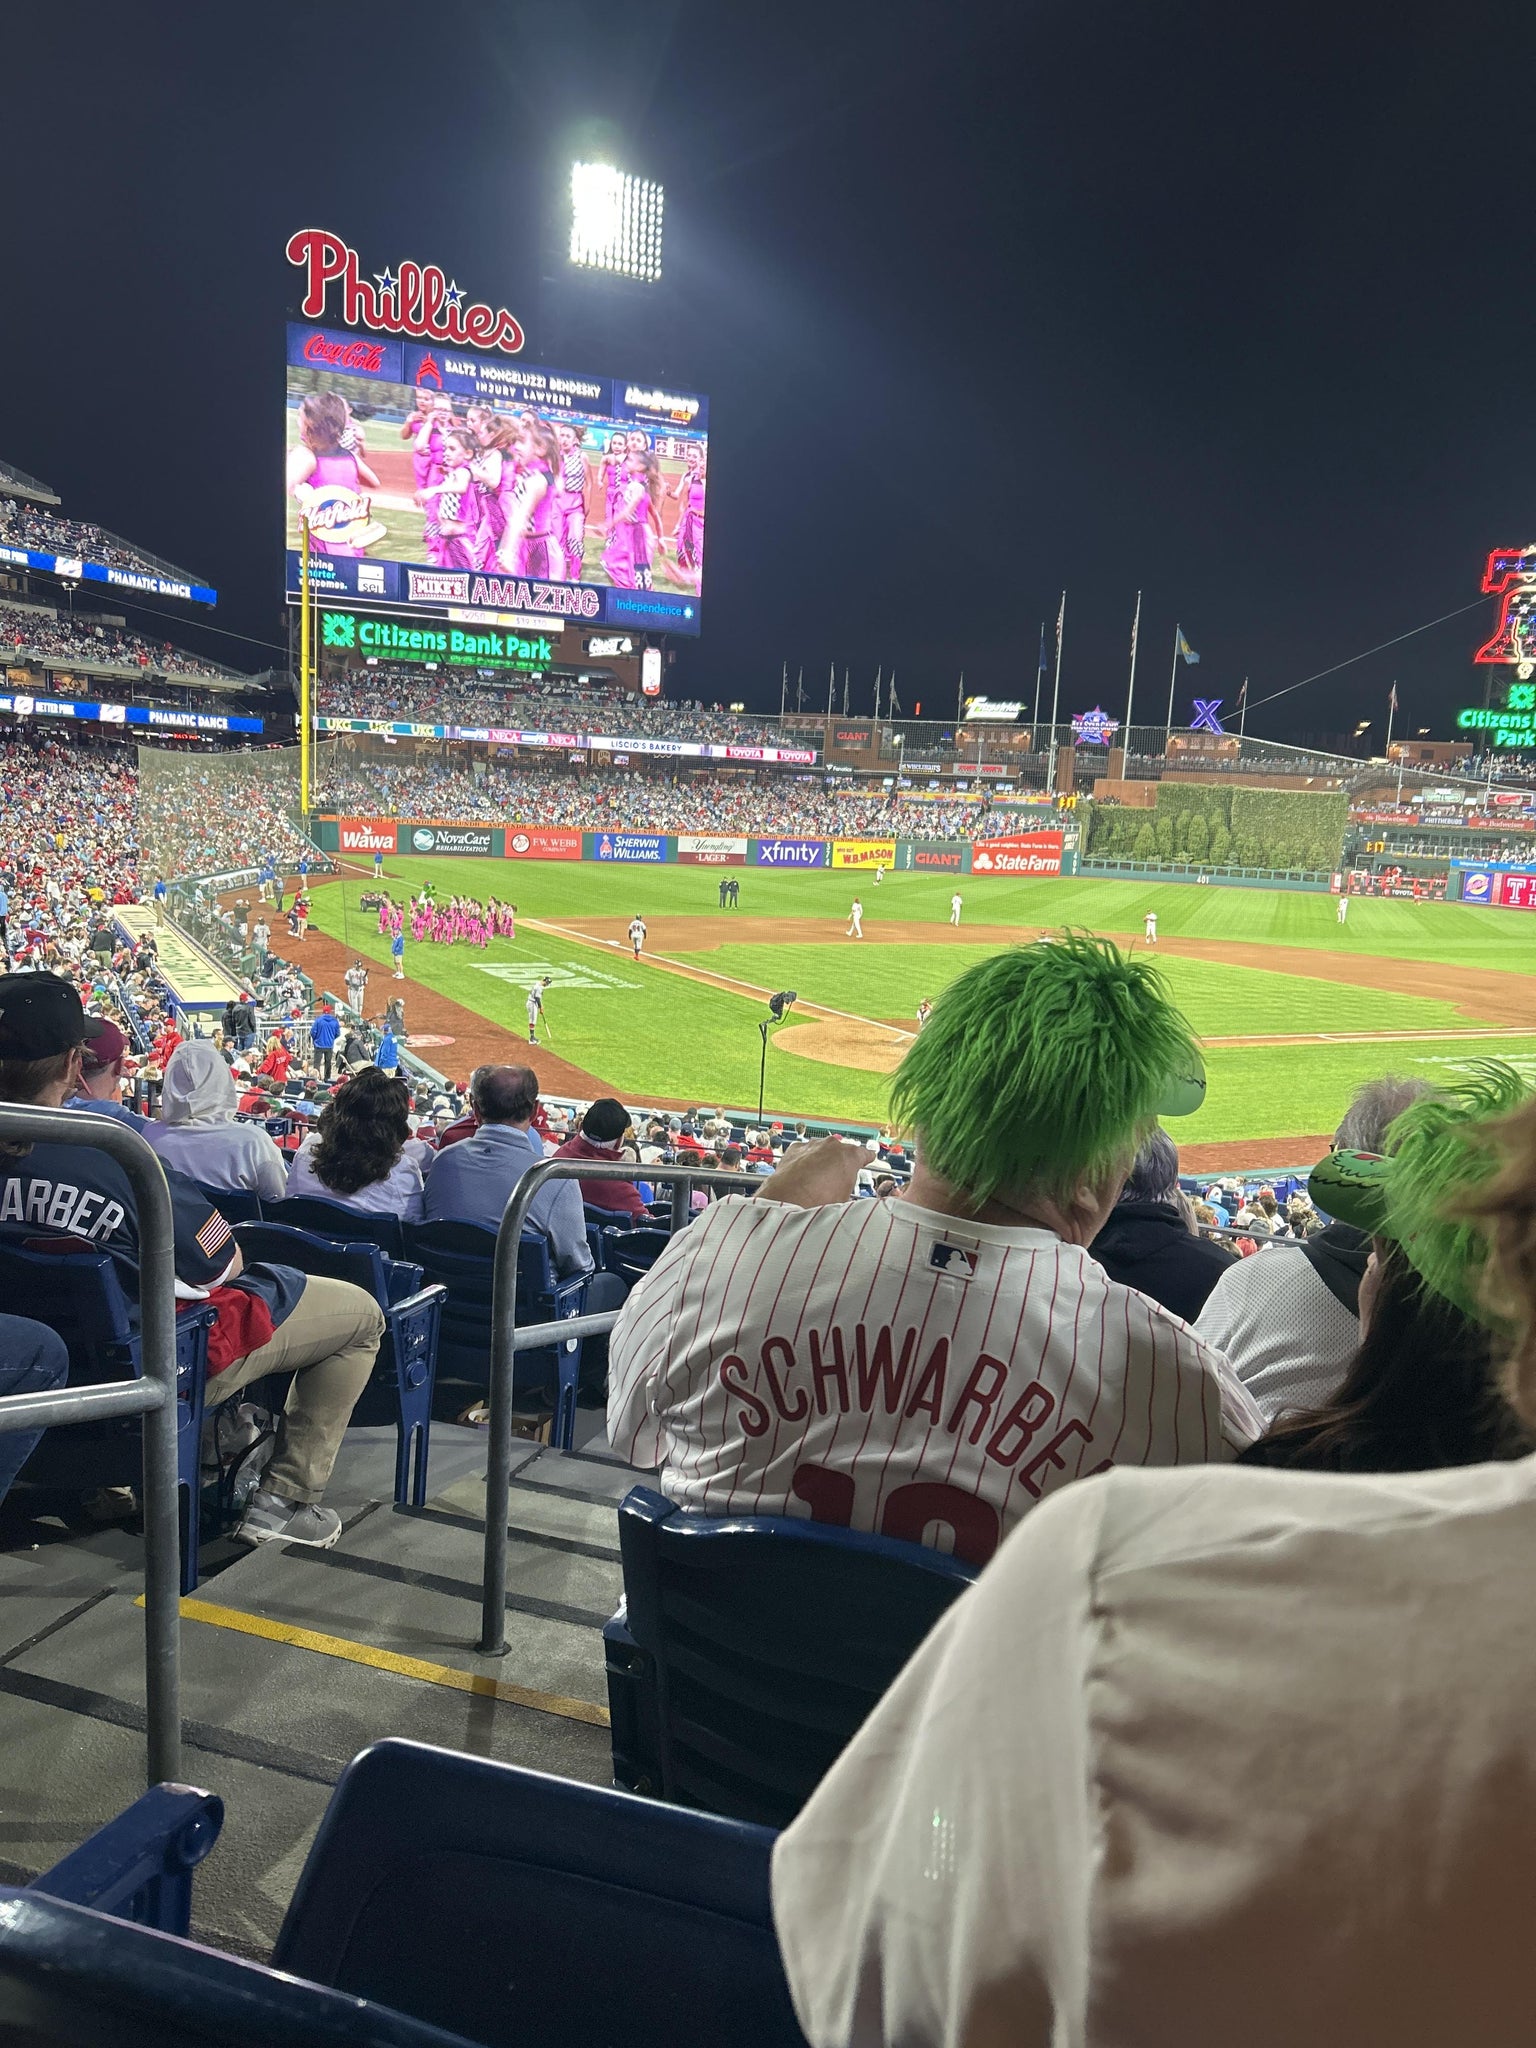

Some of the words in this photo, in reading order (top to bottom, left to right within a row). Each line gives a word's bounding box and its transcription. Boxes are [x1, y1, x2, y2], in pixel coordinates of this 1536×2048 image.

[286, 228, 525, 353] Phillies
[444, 359, 476, 378] SALTZ
[480, 365, 547, 389] MONGELUZZI
[475, 381, 516, 398] INJURY
[523, 389, 572, 408] LAWYERS
[108, 570, 157, 592] PHANATIC
[158, 579, 191, 598] DANCE
[298, 577, 348, 590] tcomes.
[415, 577, 464, 598] MIKE'S
[472, 576, 599, 617] AMAZING
[616, 599, 682, 617] Independence
[359, 622, 448, 652] Citizens
[449, 630, 504, 656] Bank
[506, 635, 552, 661] Park
[149, 711, 197, 728] PHANATIC
[197, 716, 228, 730] DANCE
[326, 718, 351, 730] UKG
[1459, 710, 1531, 729] Citizens
[369, 720, 394, 733] UKG
[411, 724, 435, 736] UKG
[491, 731, 520, 742] NECA
[551, 735, 576, 746] NECA
[837, 732, 869, 741] GIANT
[1497, 729, 1536, 747] Park
[611, 740, 647, 750] LISCIO'S
[649, 742, 682, 752] BAKERY
[729, 747, 762, 758] TOYOTA
[780, 751, 811, 761] TOYOTA
[1375, 815, 1409, 823] Budweiser
[1488, 820, 1525, 828] Budweiser
[343, 831, 394, 849] Wawa
[435, 831, 490, 845] NovaCare
[551, 838, 577, 848] WEBB
[615, 836, 659, 848] SHERWIN
[692, 838, 736, 851] Yuengling
[435, 845, 488, 853] REHABILITATION
[760, 842, 819, 863] xfinity
[698, 853, 727, 862] LAGER
[915, 853, 961, 865] GIANT
[1197, 876, 1210, 884] 401
[1391, 889, 1414, 897] TOYOTA
[0, 1178, 125, 1242] ARBER
[719, 1324, 1110, 1500] SCHWARBE
